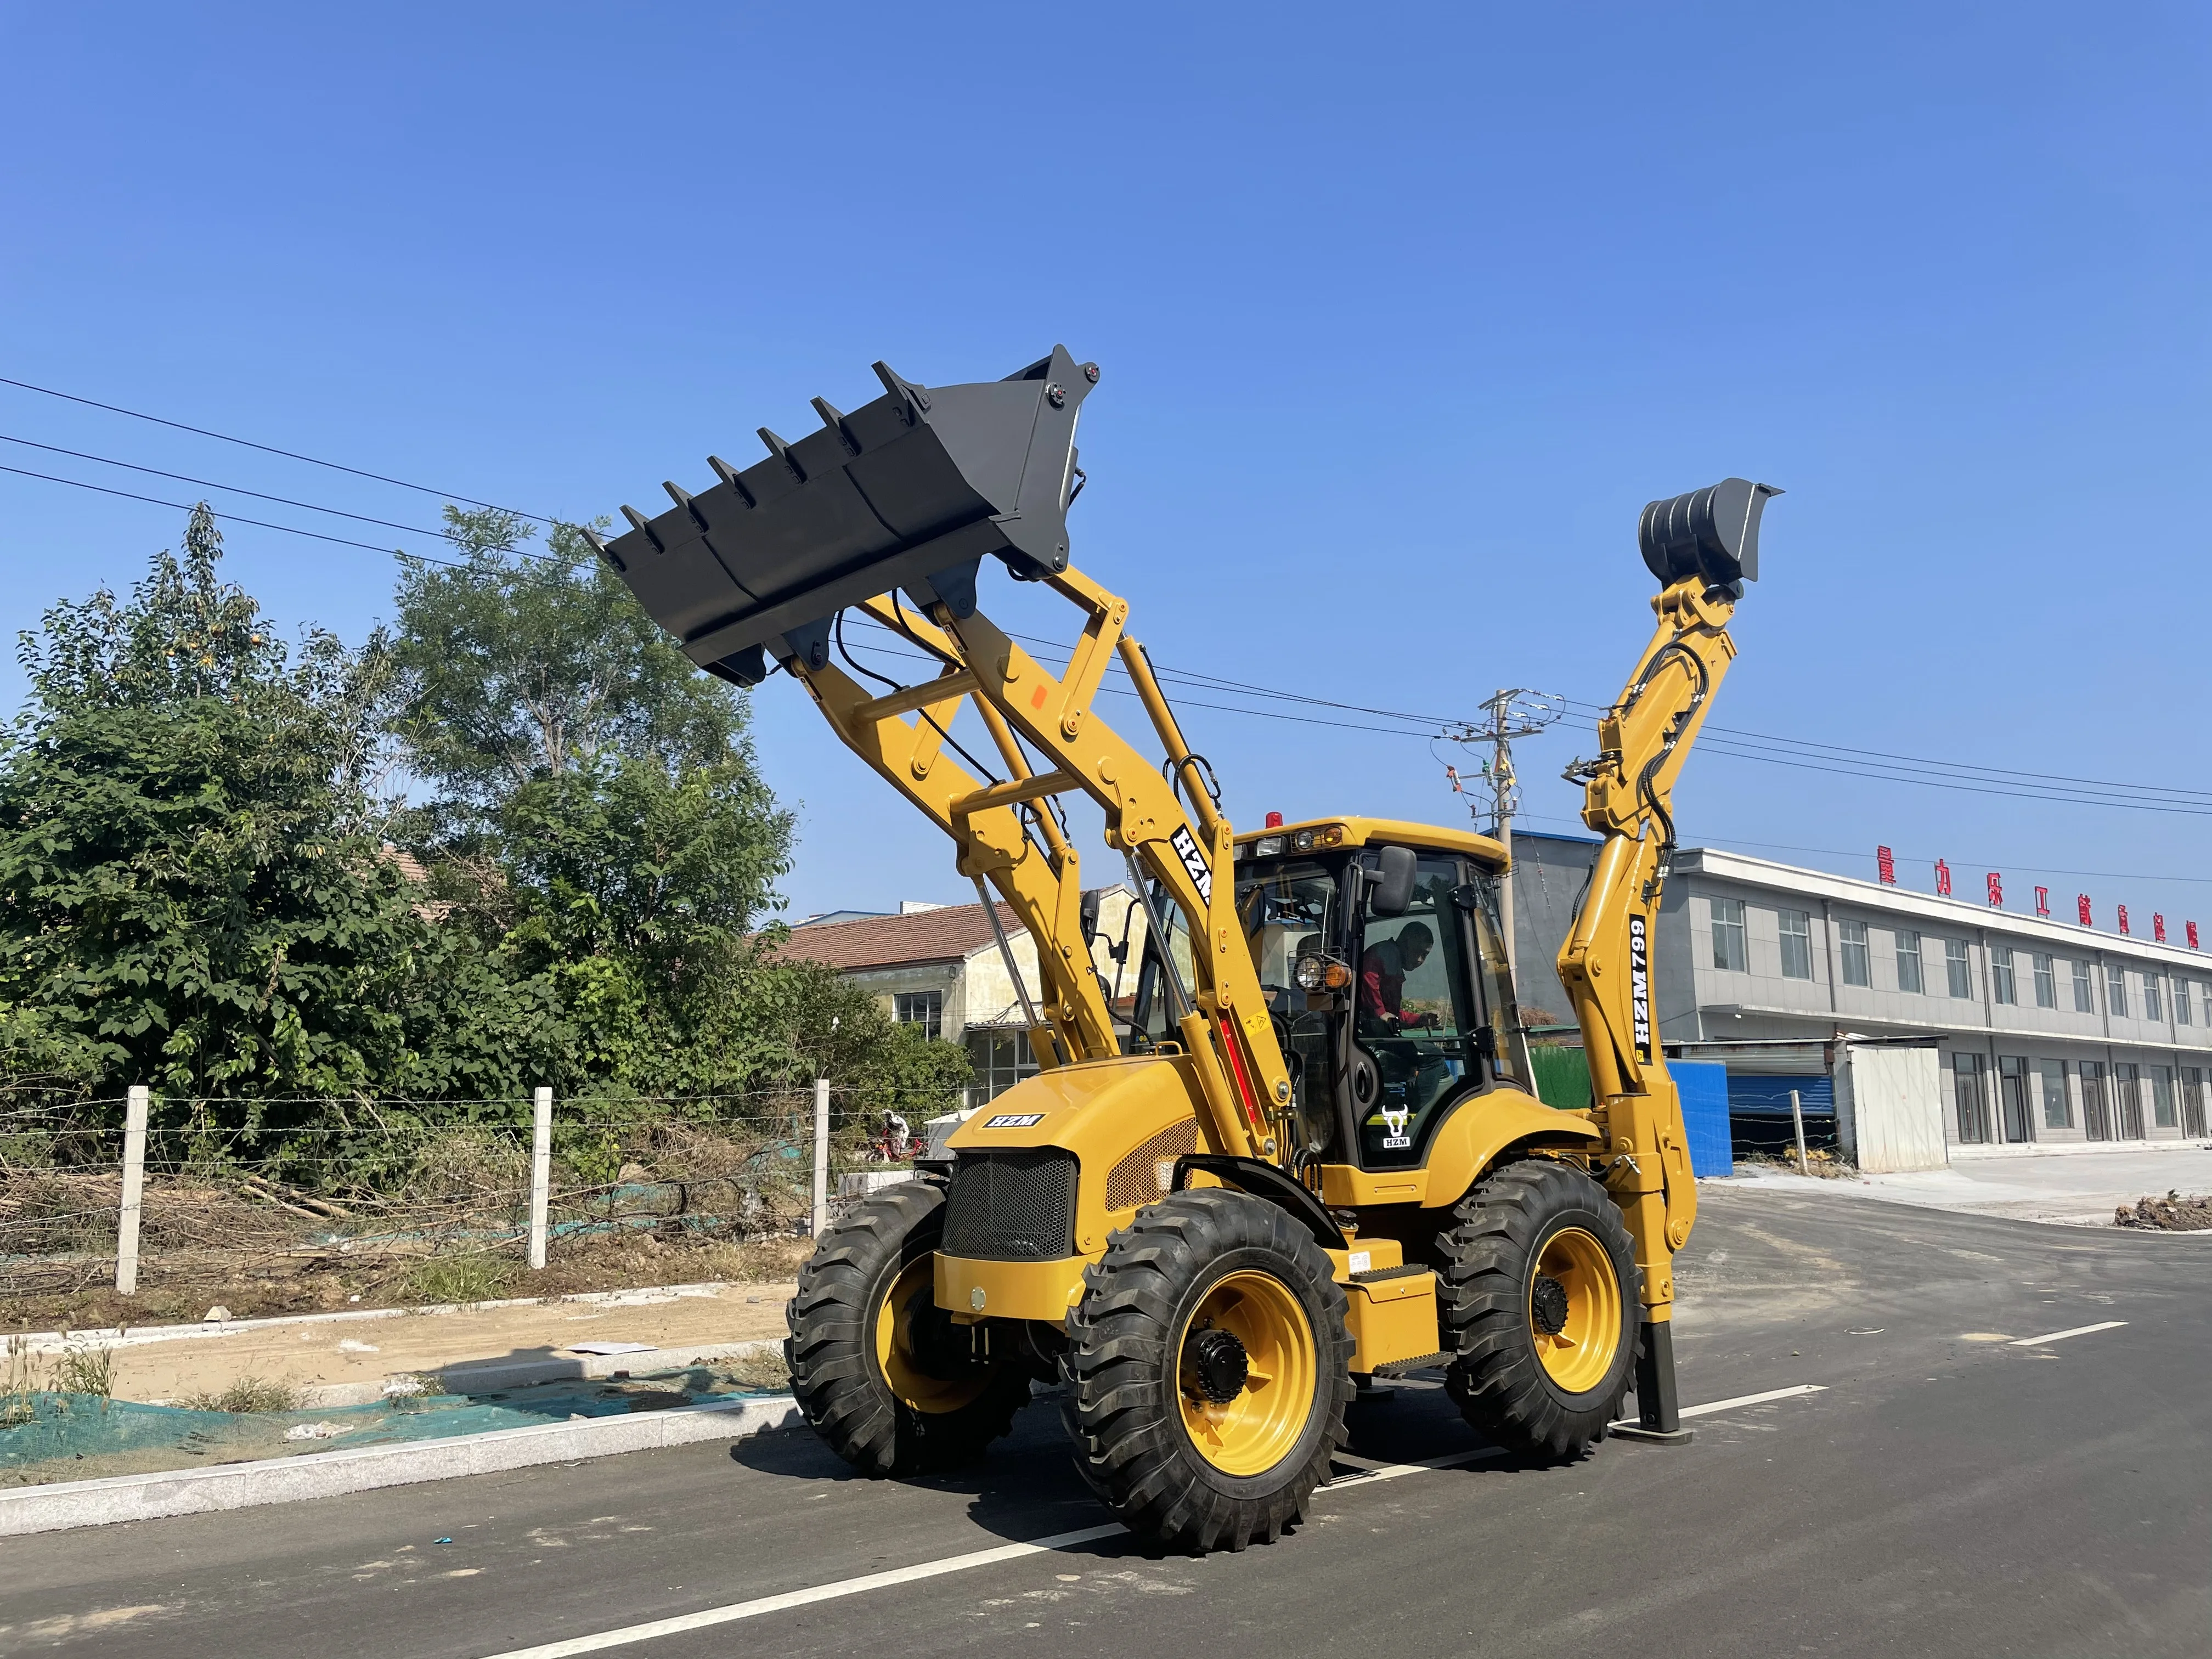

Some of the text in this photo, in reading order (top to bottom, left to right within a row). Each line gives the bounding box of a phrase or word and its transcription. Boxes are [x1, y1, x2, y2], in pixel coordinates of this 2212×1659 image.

[1631, 920, 1649, 1045] HZM799
[987, 1115, 1041, 1127] HZM
[1386, 1138, 1407, 1147] HZM
